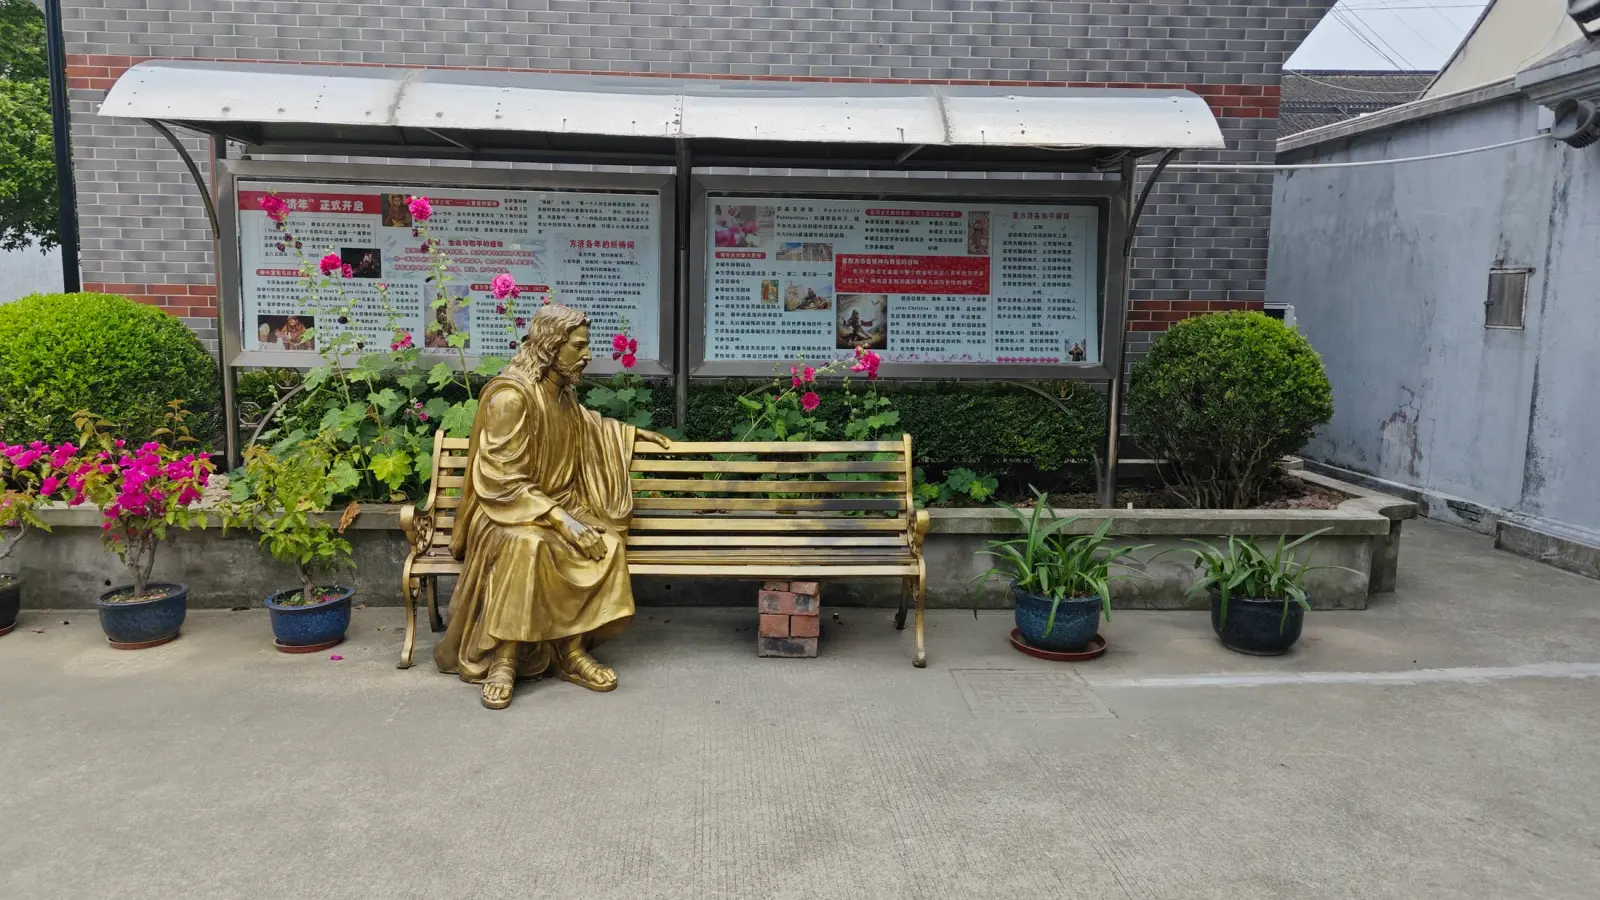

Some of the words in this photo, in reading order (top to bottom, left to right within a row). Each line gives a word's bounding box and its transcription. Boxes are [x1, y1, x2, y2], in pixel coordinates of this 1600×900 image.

[569, 240, 635, 249] 方济各年的祈祷词
